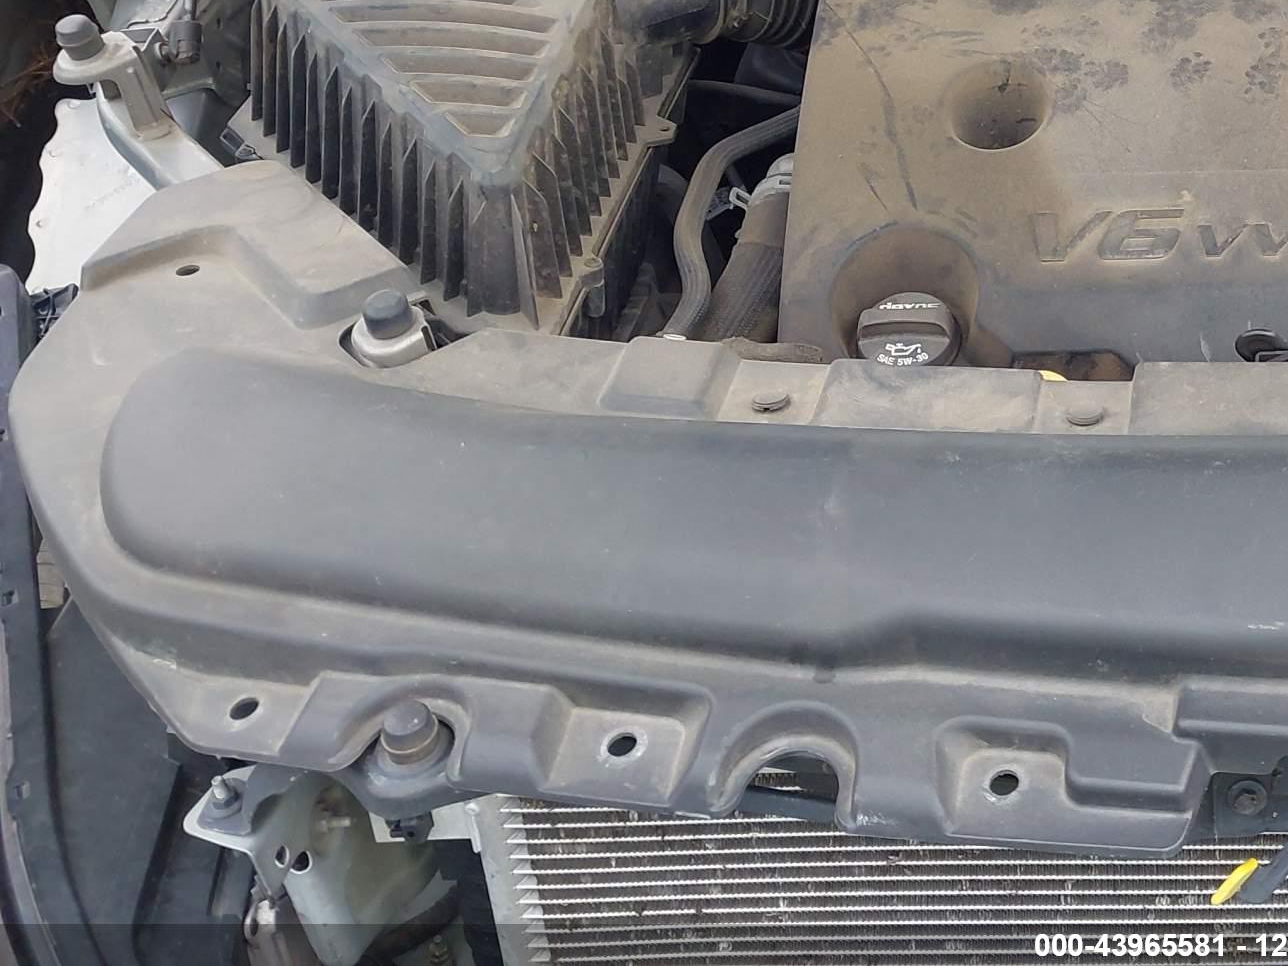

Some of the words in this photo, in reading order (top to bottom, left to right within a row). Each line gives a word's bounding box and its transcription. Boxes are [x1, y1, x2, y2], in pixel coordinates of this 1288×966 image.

[1031, 207, 1185, 263] V6
[877, 353, 896, 366] SAE
[897, 352, 929, 366] 5W-30
